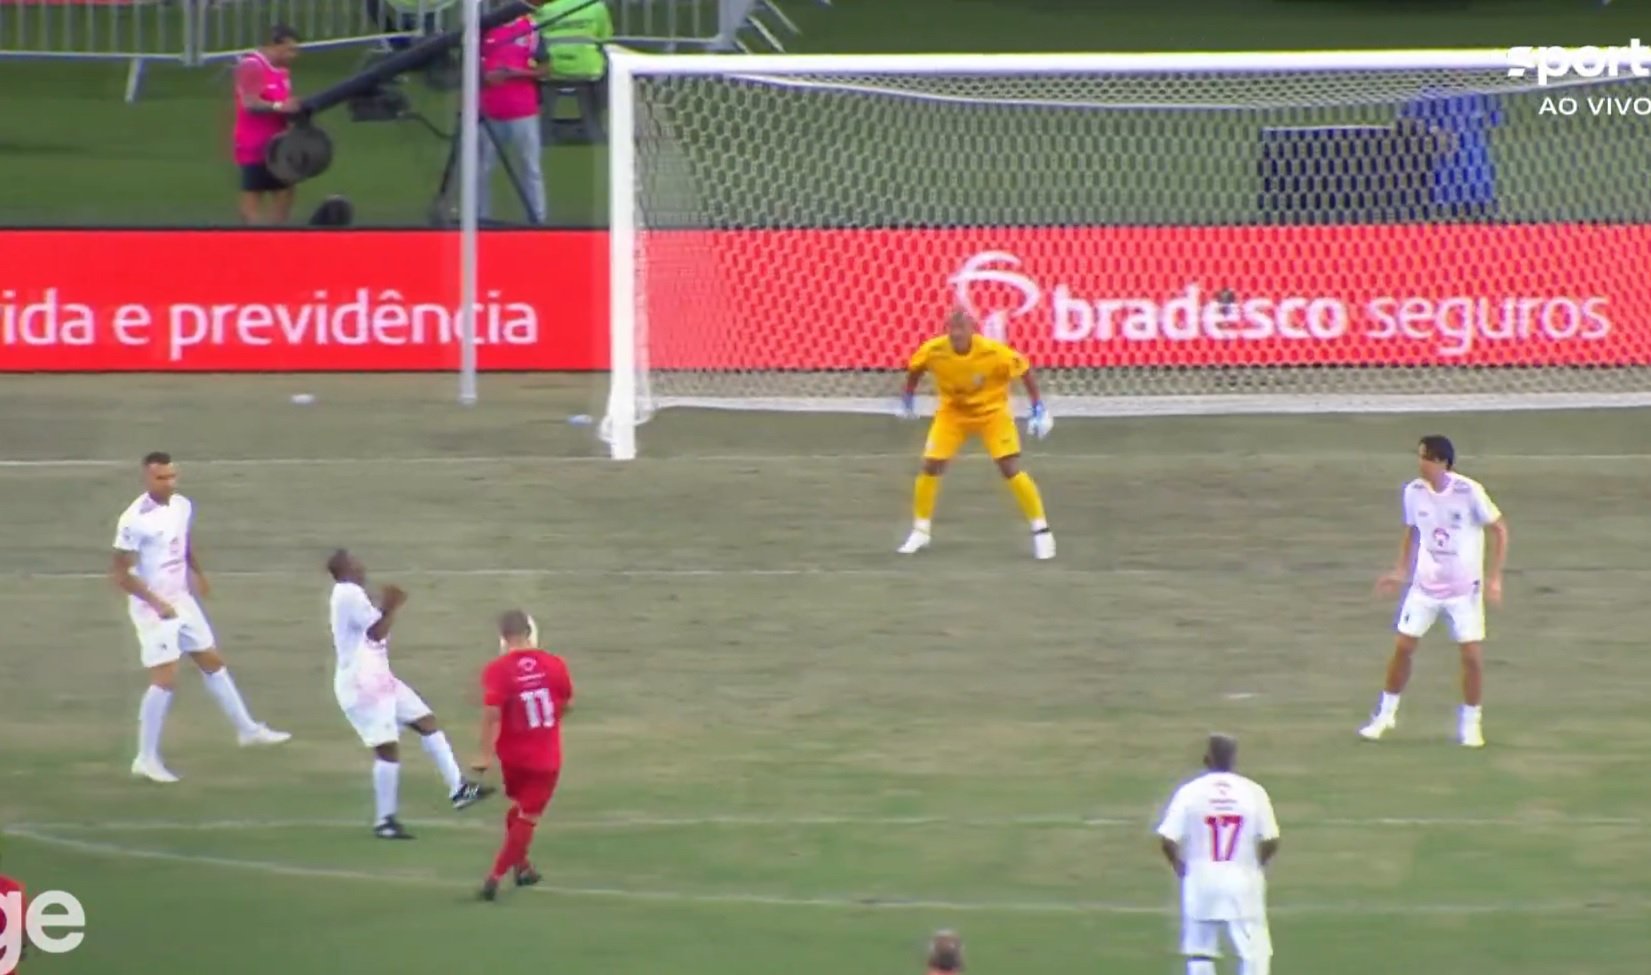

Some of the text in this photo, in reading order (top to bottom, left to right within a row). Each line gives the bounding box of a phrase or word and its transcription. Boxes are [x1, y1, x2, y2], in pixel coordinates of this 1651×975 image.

[0, 287, 96, 345] ida
[112, 302, 152, 345] e
[1053, 283, 1612, 355] bradesco seguros
[519, 687, 555, 729] 11
[1205, 814, 1243, 862] 17
